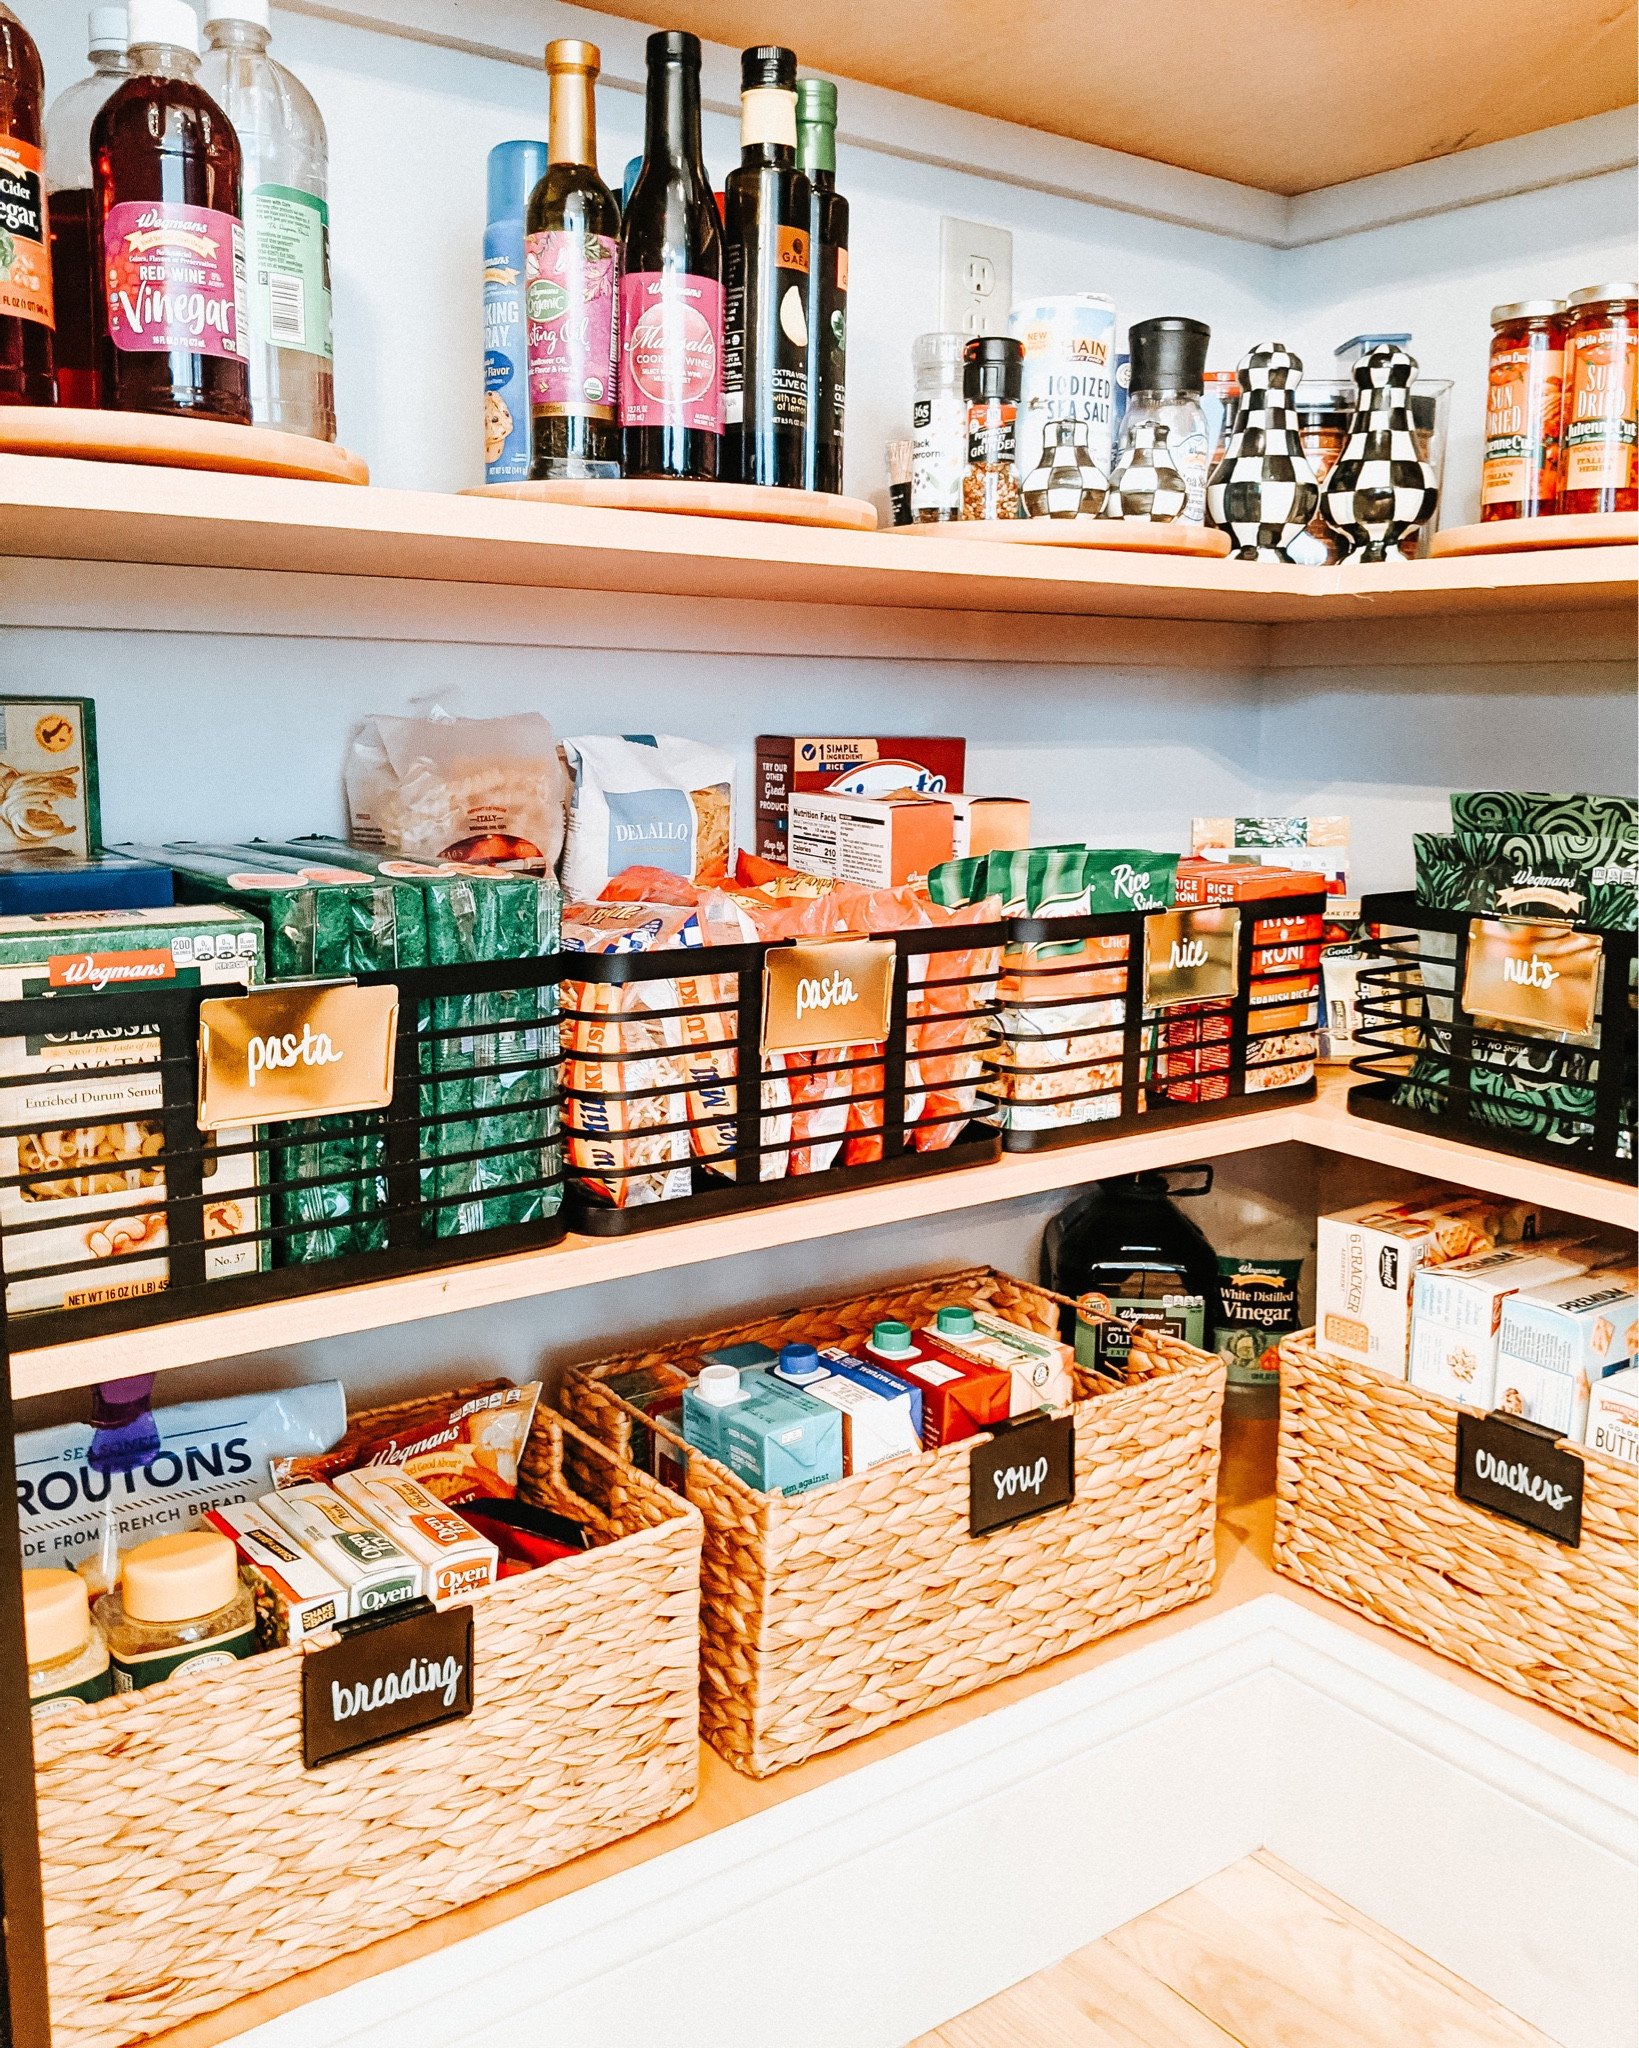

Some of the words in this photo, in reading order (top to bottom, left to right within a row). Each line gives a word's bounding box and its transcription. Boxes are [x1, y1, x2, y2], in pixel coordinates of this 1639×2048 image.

[1, 178, 31, 201] Cider
[136, 209, 208, 233] Wegmans
[140, 265, 166, 281] RED
[171, 267, 207, 285] WINE
[118, 280, 235, 335] Vinegar
[528, 296, 564, 317] Organic
[1027, 331, 1048, 341] NEW
[487, 366, 510, 376] Flavor
[771, 368, 797, 378] EXTRA
[1586, 365, 1618, 392] SUN
[771, 378, 800, 390] OLIVE
[1048, 375, 1110, 400] IODIZED
[772, 394, 790, 402] with
[776, 403, 786, 411] of
[1491, 386, 1513, 411] SUN
[1083, 401, 1110, 424] SALT
[1617, 419, 1638, 437] Cut
[970, 439, 1016, 458] GRIDER
[818, 744, 825, 761] 1
[826, 744, 859, 753] SIMPLE
[762, 762, 774, 772] TRY
[773, 763, 788, 772] OUR
[765, 773, 784, 781] OTHER
[825, 763, 845, 771] RICE
[764, 781, 786, 799] Great
[476, 814, 498, 823] ITALY
[793, 807, 819, 820] Nutrition
[820, 812, 837, 823] Facts
[615, 822, 688, 843] DELALLO
[793, 844, 812, 853] Calories
[824, 847, 837, 858] 210
[1110, 864, 1151, 900] Rice
[1511, 866, 1576, 888] Wegmans
[1206, 882, 1235, 896] RICE
[173, 939, 191, 951] 200
[1168, 937, 1209, 970] rice
[1326, 945, 1353, 957] Good
[61, 955, 166, 991] Wegmans
[1502, 953, 1561, 990] nuts
[796, 968, 859, 1020] pasta
[95, 1045, 111, 1054] The
[113, 1043, 134, 1053] Taste
[136, 1041, 144, 1052] of
[247, 1022, 344, 1088] pasta
[1487, 1041, 1502, 1050] NO
[26, 1093, 79, 1110] Enriched
[81, 1090, 125, 1105] Durum
[1350, 1233, 1361, 1243] 6
[214, 1255, 233, 1268] No.
[234, 1252, 246, 1264] 37
[1238, 1262, 1281, 1275] Wegmans
[1347, 1246, 1363, 1314] CRACKER
[68, 1293, 87, 1307] NET
[87, 1291, 104, 1304] WT
[105, 1289, 117, 1300] 16
[117, 1286, 130, 1298] OZ
[130, 1284, 140, 1298] (1
[140, 1281, 157, 1296] LB)
[1220, 1287, 1252, 1301] White
[1253, 1290, 1294, 1302] Distilled
[1556, 1287, 1628, 1312] PREMIUM
[1119, 1307, 1164, 1322] Wegmans
[1221, 1300, 1291, 1326] Vinegar
[366, 1425, 460, 1471] Wegmans
[798, 1473, 830, 1490] against
[993, 1456, 1049, 1500] soup
[1475, 1449, 1573, 1511] crackers
[53, 1528, 100, 1550] FROM
[109, 1507, 181, 1535] FRENCH
[188, 1493, 247, 1516] BREAD
[437, 1565, 489, 1590] Oven
[361, 1584, 414, 1610] Oven
[302, 1602, 335, 1624] SHAKE
[311, 1611, 336, 1628] BAKE
[331, 1655, 463, 1722] breading
